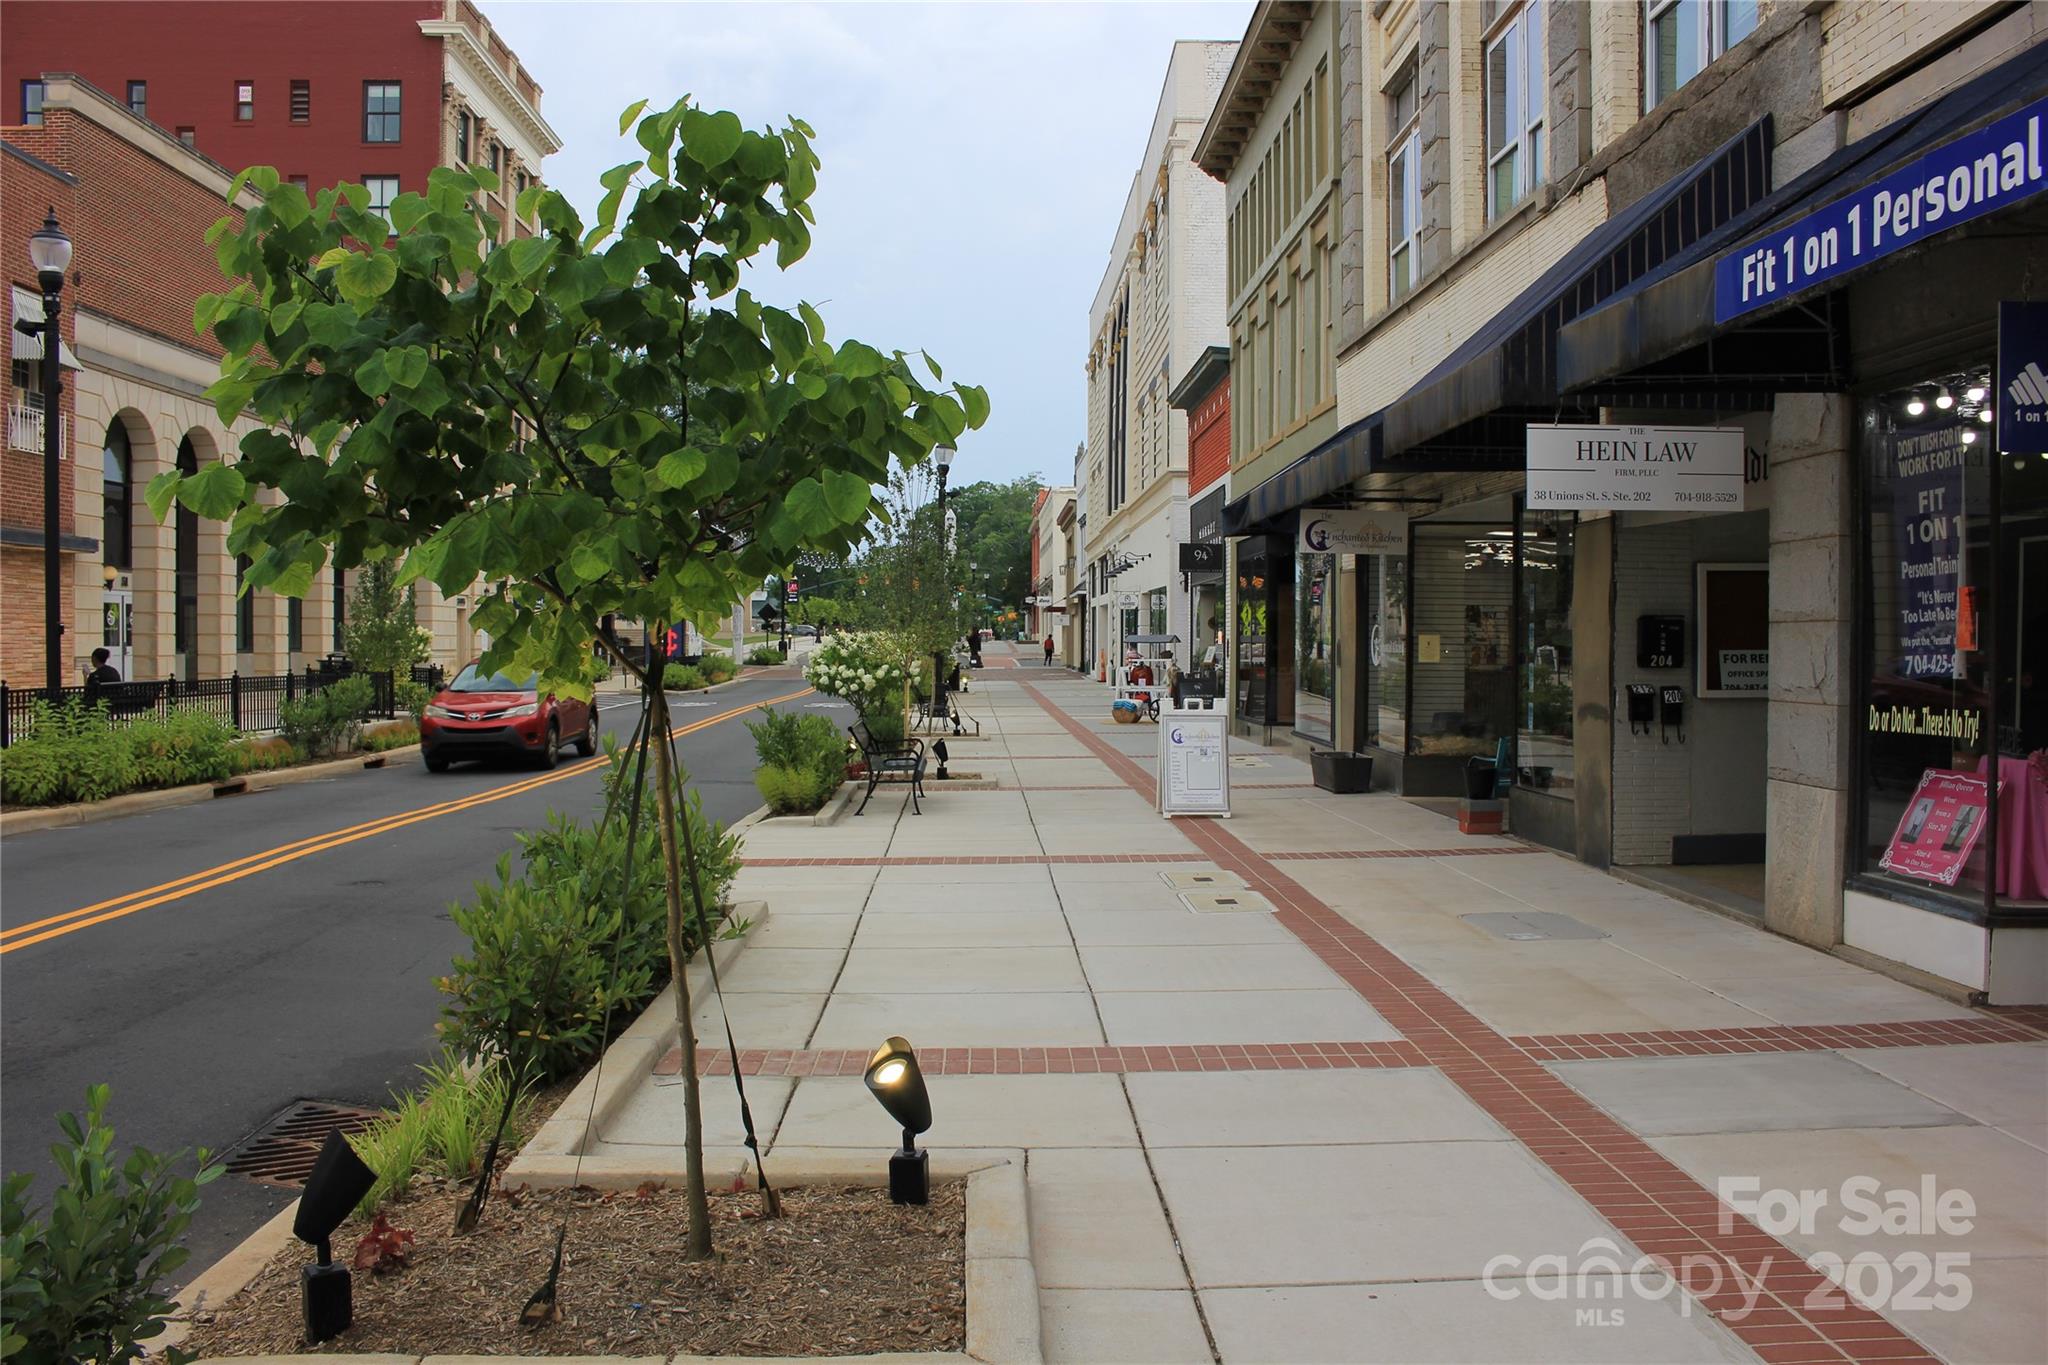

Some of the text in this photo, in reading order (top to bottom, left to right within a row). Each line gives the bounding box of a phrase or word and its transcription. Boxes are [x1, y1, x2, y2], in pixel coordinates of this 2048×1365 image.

[1742, 115, 2042, 302] Fit 1 on 1 Personal
[2015, 409, 2021, 422] 1
[2026, 412, 2040, 423] on
[1629, 427, 1646, 435] THE
[1920, 431, 1938, 453] WISH
[1939, 427, 1954, 448] FOR
[1576, 440, 1697, 463] HEIN LAW
[1897, 446, 1963, 478] WORK FOR IT
[1614, 468, 1660, 478] FIRM, PLLC
[1534, 490, 1651, 502] 38 Unions St. S. Ste. 202
[1674, 491, 1737, 503] 704-918-5529
[1918, 487, 1946, 514] FIT
[1906, 523, 1914, 544] 1
[1919, 516, 1948, 543] ON
[1194, 549, 1208, 561] 94
[1901, 556, 1936, 579] Personal
[1934, 590, 1955, 603] Never
[1901, 609, 1918, 624] Too
[1919, 608, 1937, 623] Late
[1936, 607, 1945, 621] To
[1650, 655, 1673, 666] 204
[1723, 653, 1747, 664] FOR
[1727, 670, 1754, 678] OFFICE
[1869, 704, 1880, 731] Do
[1881, 711, 1890, 732] or
[1891, 705, 1901, 733] Do
[1943, 708, 1950, 737] Is
[1951, 709, 1962, 738] No
[1963, 710, 1980, 747] Try!
